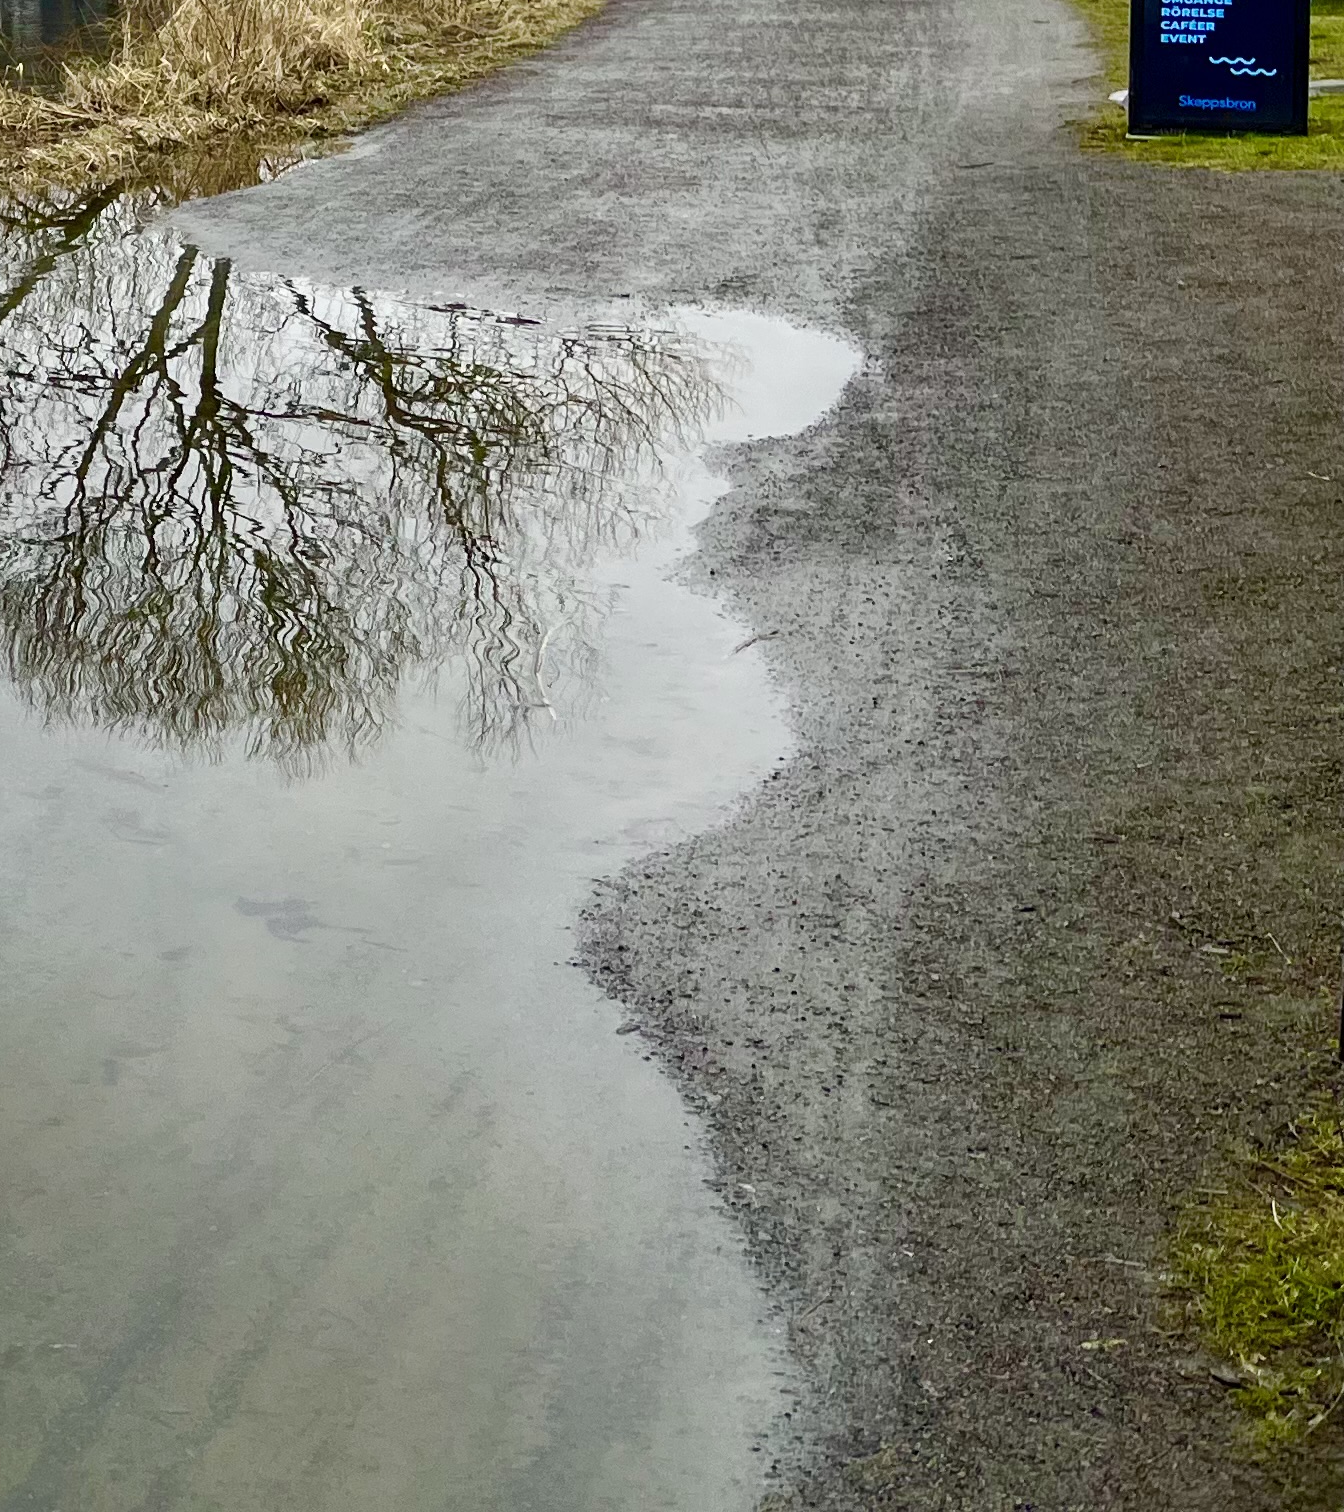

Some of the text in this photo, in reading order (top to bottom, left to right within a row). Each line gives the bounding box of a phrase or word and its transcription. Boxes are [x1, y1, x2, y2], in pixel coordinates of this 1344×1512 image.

[1160, 6, 1224, 18] RÖRELSE
[1160, 19, 1215, 31] CAFÉER
[1160, 33, 1207, 44] EVENT
